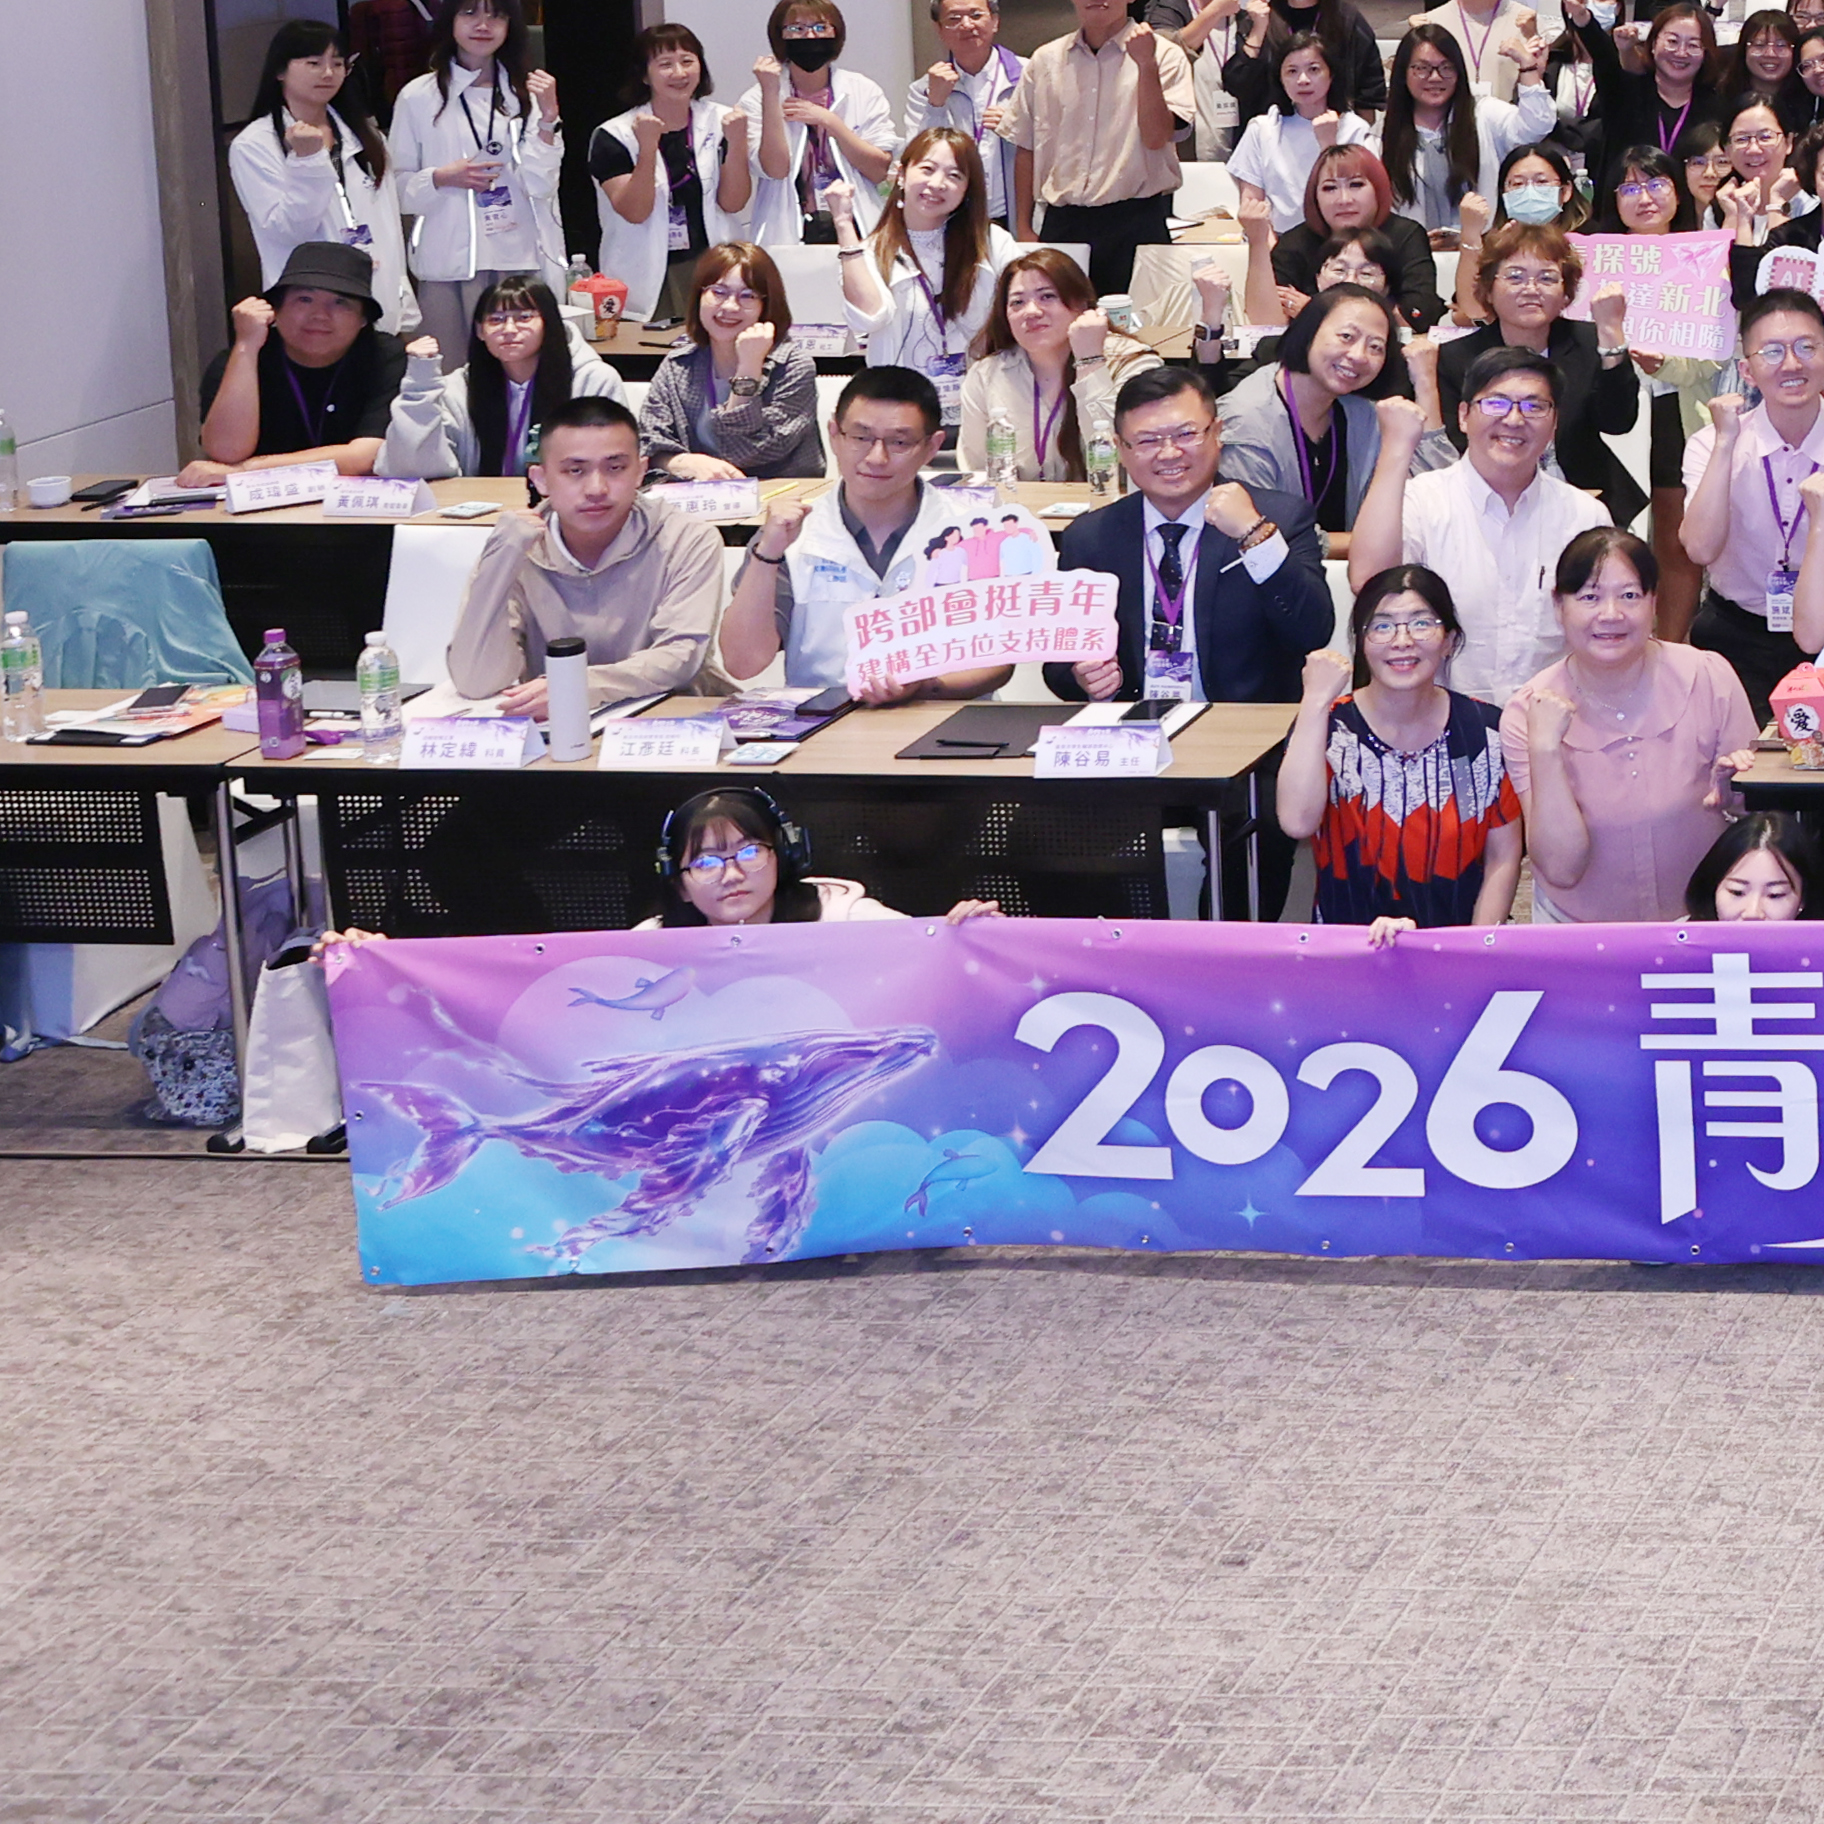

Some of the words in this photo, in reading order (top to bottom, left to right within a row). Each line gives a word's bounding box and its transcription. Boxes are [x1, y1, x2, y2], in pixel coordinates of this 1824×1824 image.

[854, 579, 1108, 651] 跨部會挺青年
[856, 625, 1106, 681] 建構全方位支持體系
[1789, 708, 1817, 733] 愛
[420, 742, 478, 758] 林定緯
[1054, 750, 1111, 768] 陳谷易
[1119, 756, 1140, 767] 主任
[1012, 989, 1580, 1198] 2026
